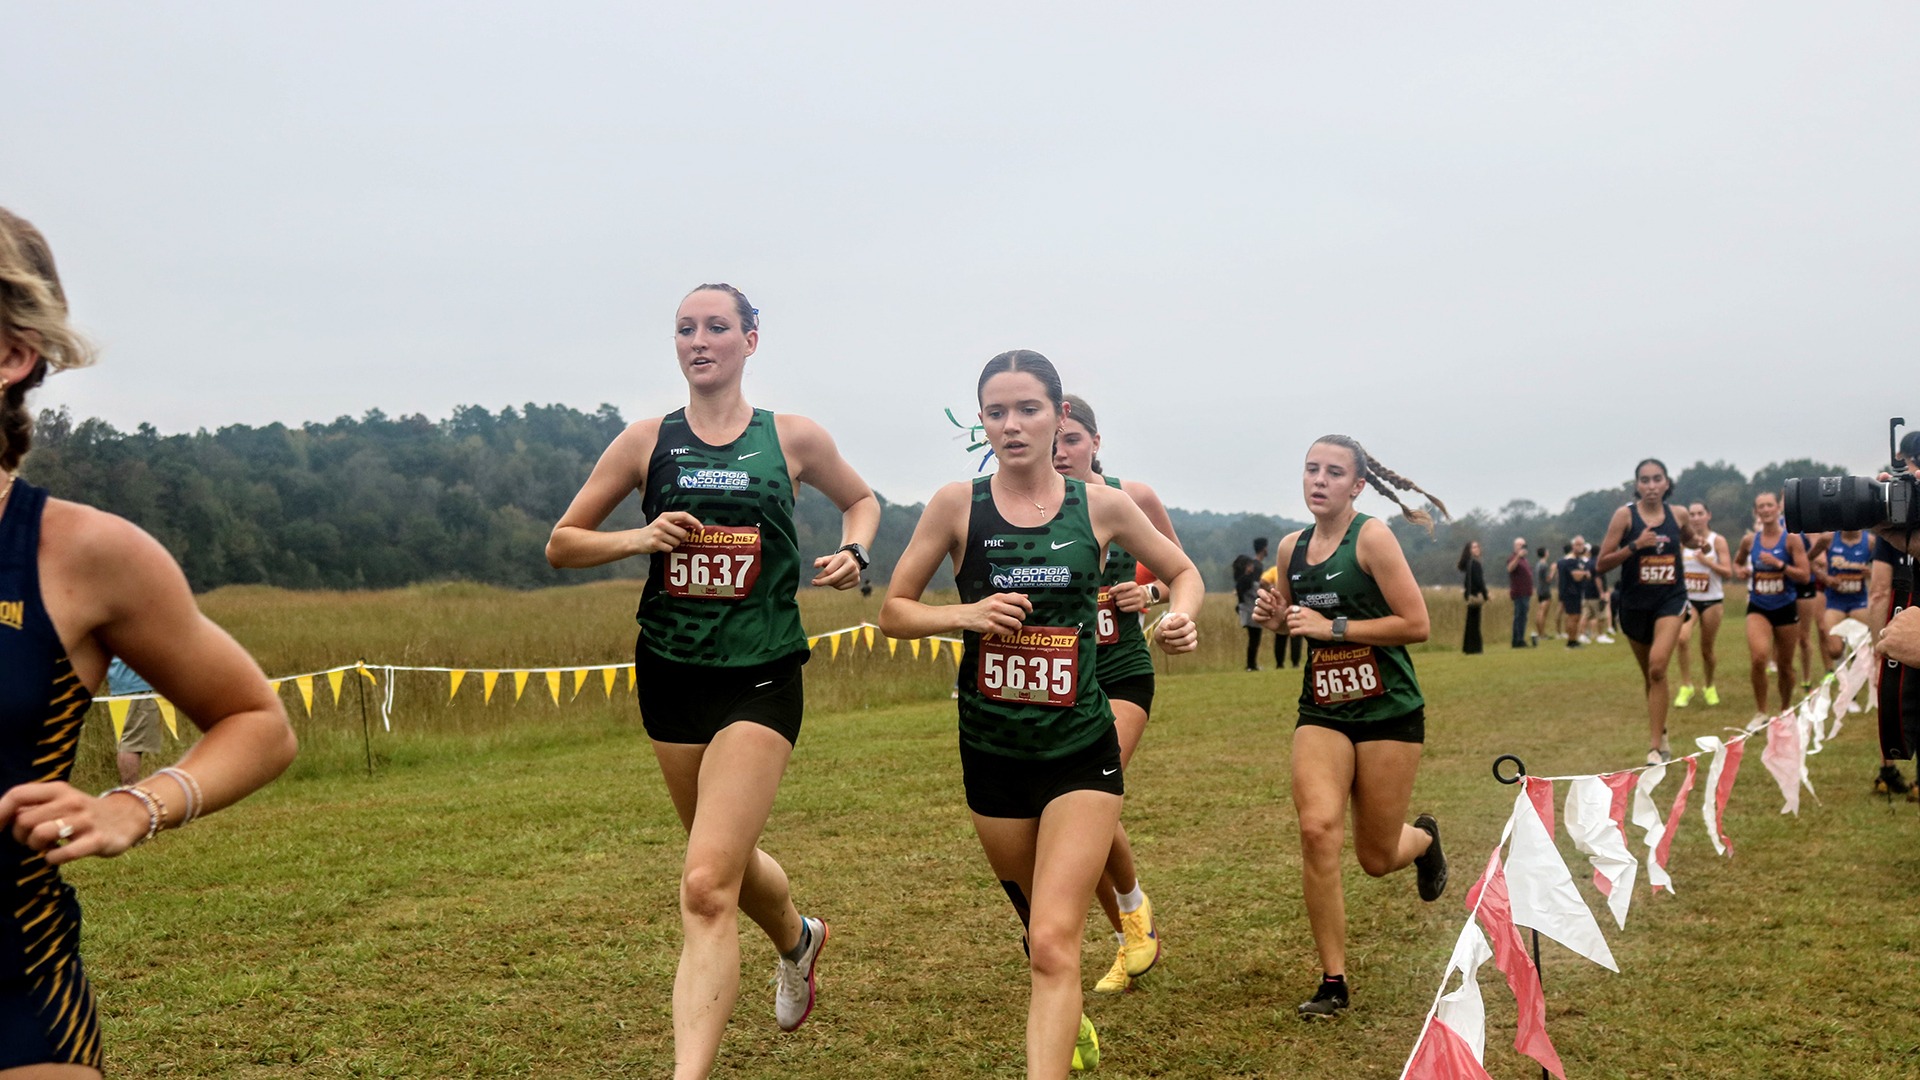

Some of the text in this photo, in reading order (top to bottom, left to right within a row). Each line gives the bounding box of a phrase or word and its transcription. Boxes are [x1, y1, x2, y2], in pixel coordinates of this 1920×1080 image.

[697, 470, 748, 479] GEORGIA
[697, 478, 749, 486] COLLEGE
[686, 528, 734, 544] thletic
[984, 539, 1005, 547] PBC
[670, 552, 755, 589] 5637
[1012, 567, 1069, 576] GEORGIA
[1640, 565, 1675, 581] 5572
[1013, 575, 1070, 583] COLLEGE
[1306, 592, 1338, 601] GEORGIA
[1052, 637, 1074, 646] NET
[984, 652, 1073, 695] 5635
[1315, 663, 1377, 698] 5638
